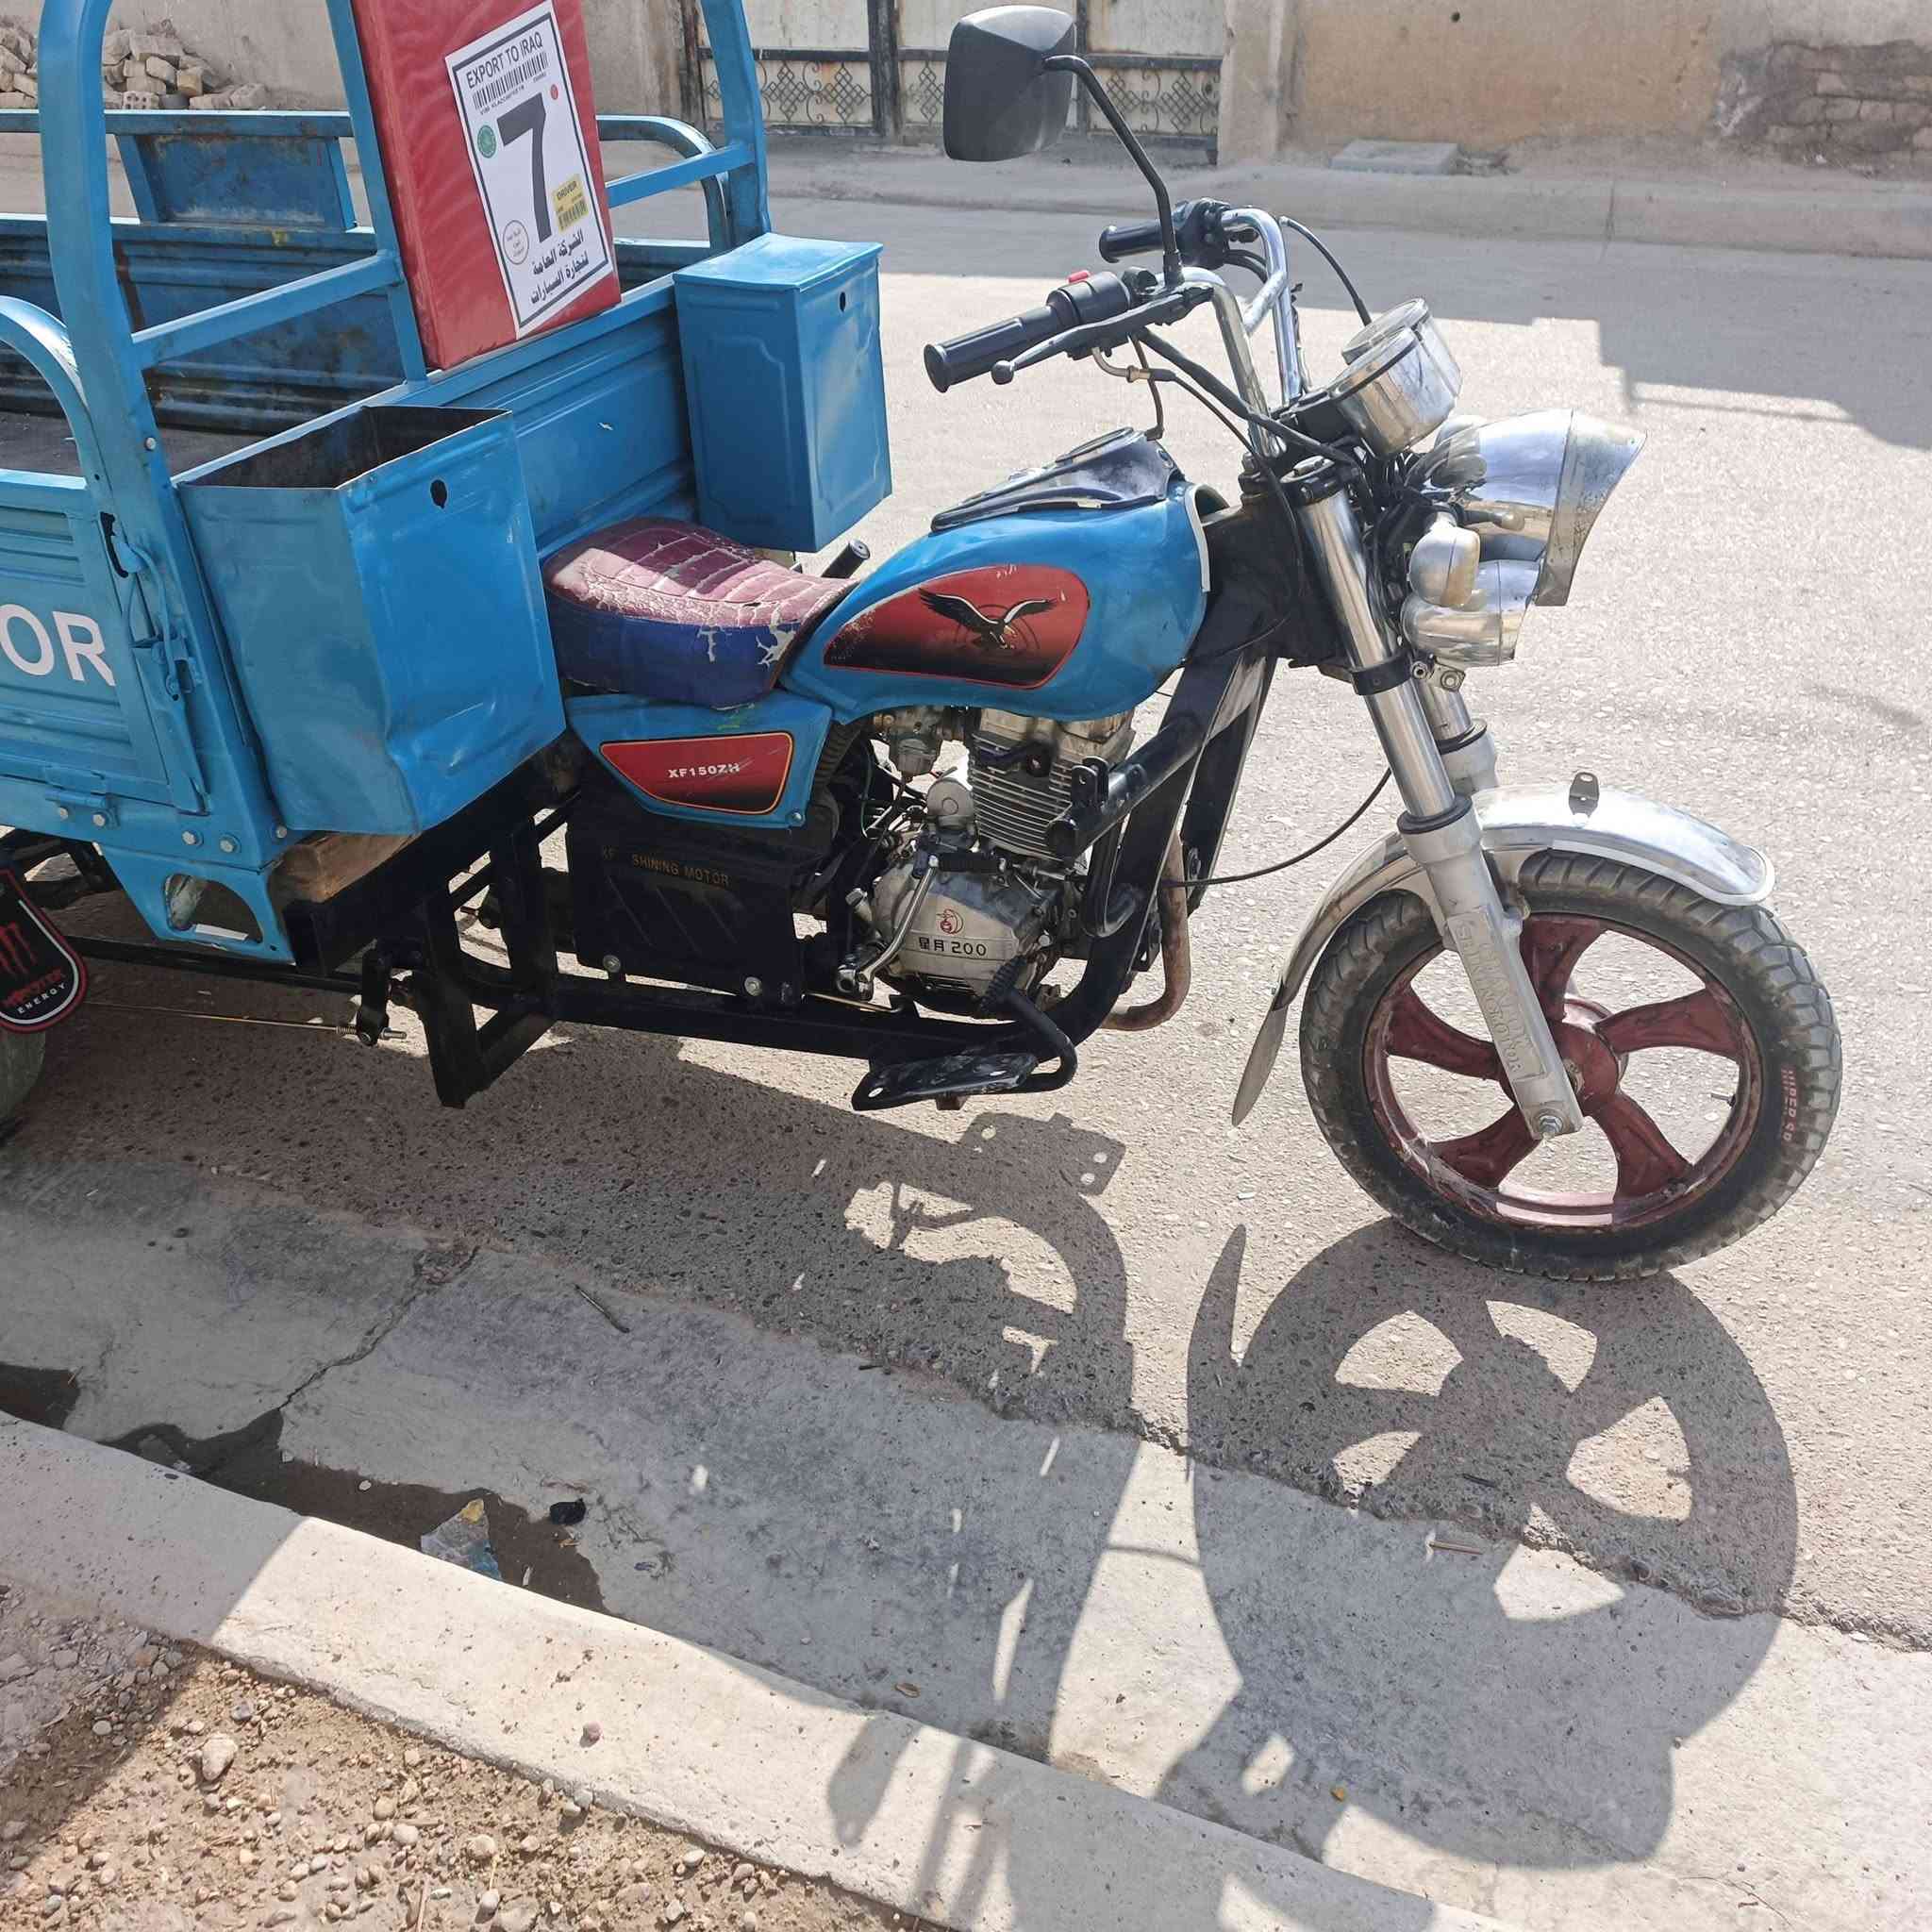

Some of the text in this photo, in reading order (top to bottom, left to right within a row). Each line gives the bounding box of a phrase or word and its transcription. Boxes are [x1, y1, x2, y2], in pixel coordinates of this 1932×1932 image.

[466, 31, 543, 89] EXPORT TO IRAQ
[496, 92, 552, 242] 7
[558, 227, 584, 257] الشركة
[533, 248, 558, 275] العامة
[530, 269, 565, 304] السيارات
[0, 604, 116, 687] OR
[668, 762, 741, 778] XF150ZH
[631, 853, 679, 875] SHINING
[685, 866, 729, 887] MOTOR
[950, 941, 987, 957] 200
[16, 983, 66, 1014] ENERGY
